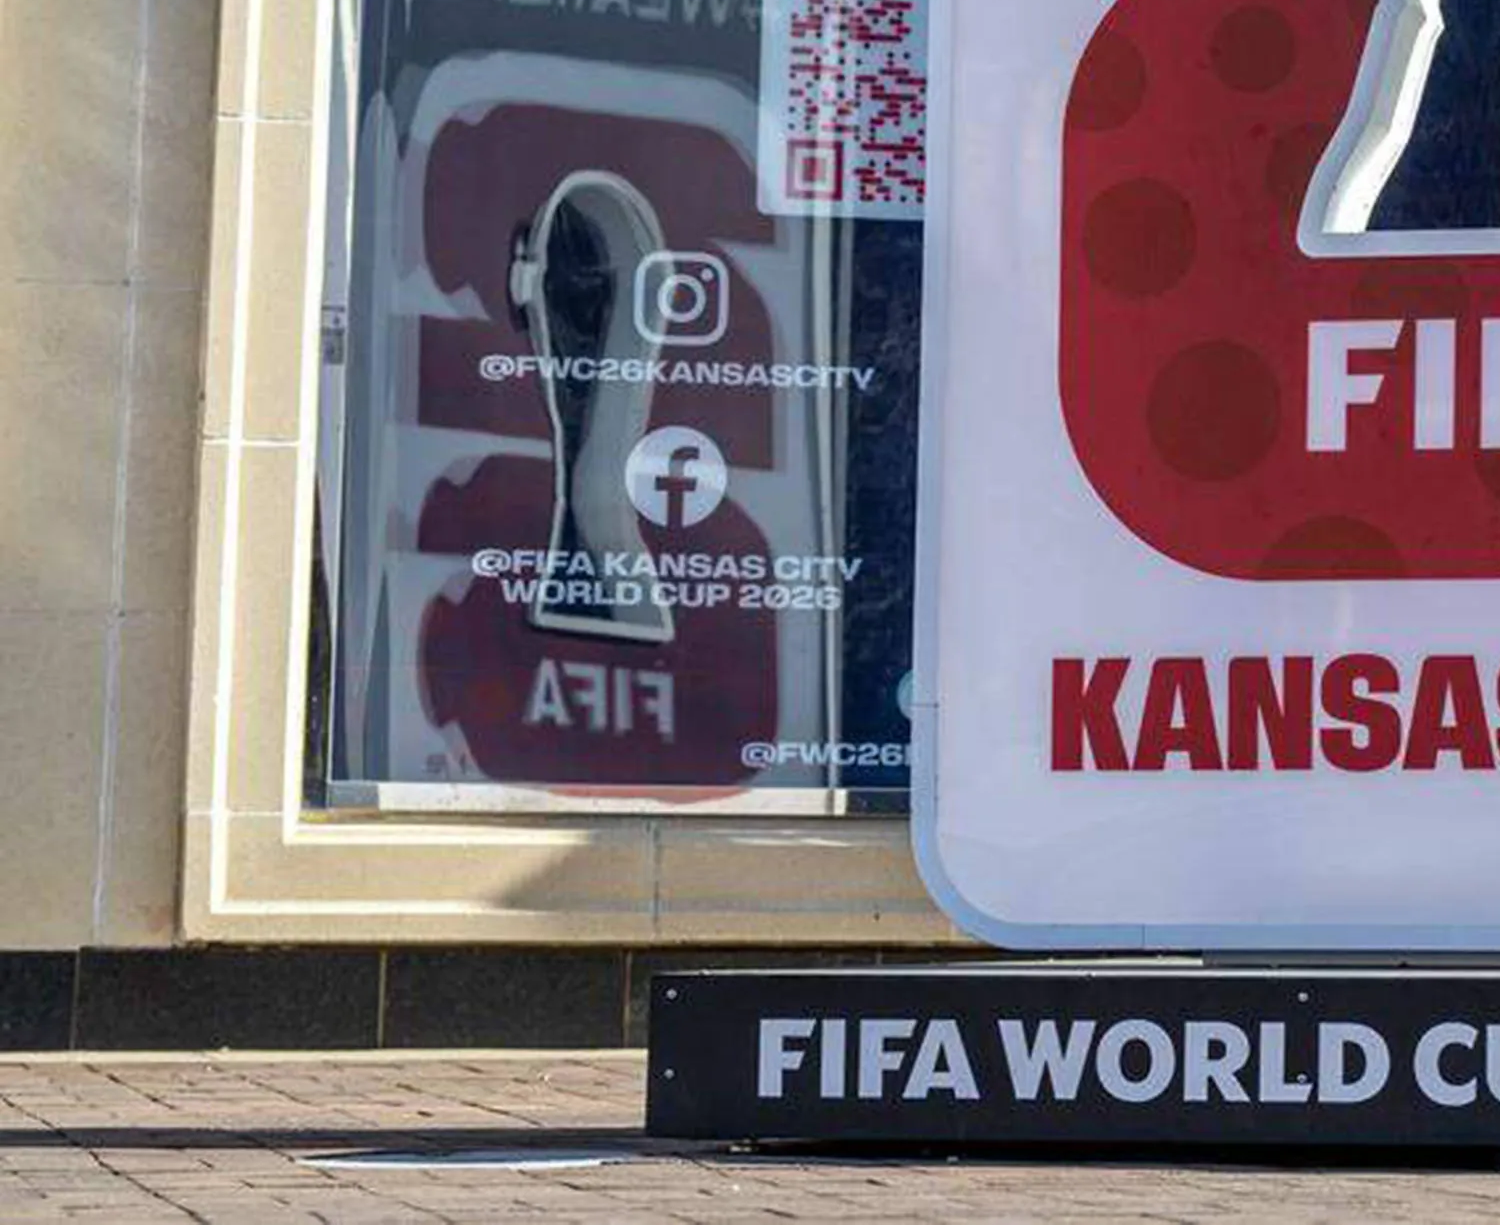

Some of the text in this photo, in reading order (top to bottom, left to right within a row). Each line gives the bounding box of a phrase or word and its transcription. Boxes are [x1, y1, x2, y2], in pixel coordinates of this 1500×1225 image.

[478, 353, 876, 391] @FWC26KANSASCITY
[471, 547, 863, 582] @FIFA KANSAS CITY
[501, 578, 843, 611] WORLD CUP 2026
[757, 1018, 981, 1100] FIFA
[997, 1018, 1391, 1103] WORLD
